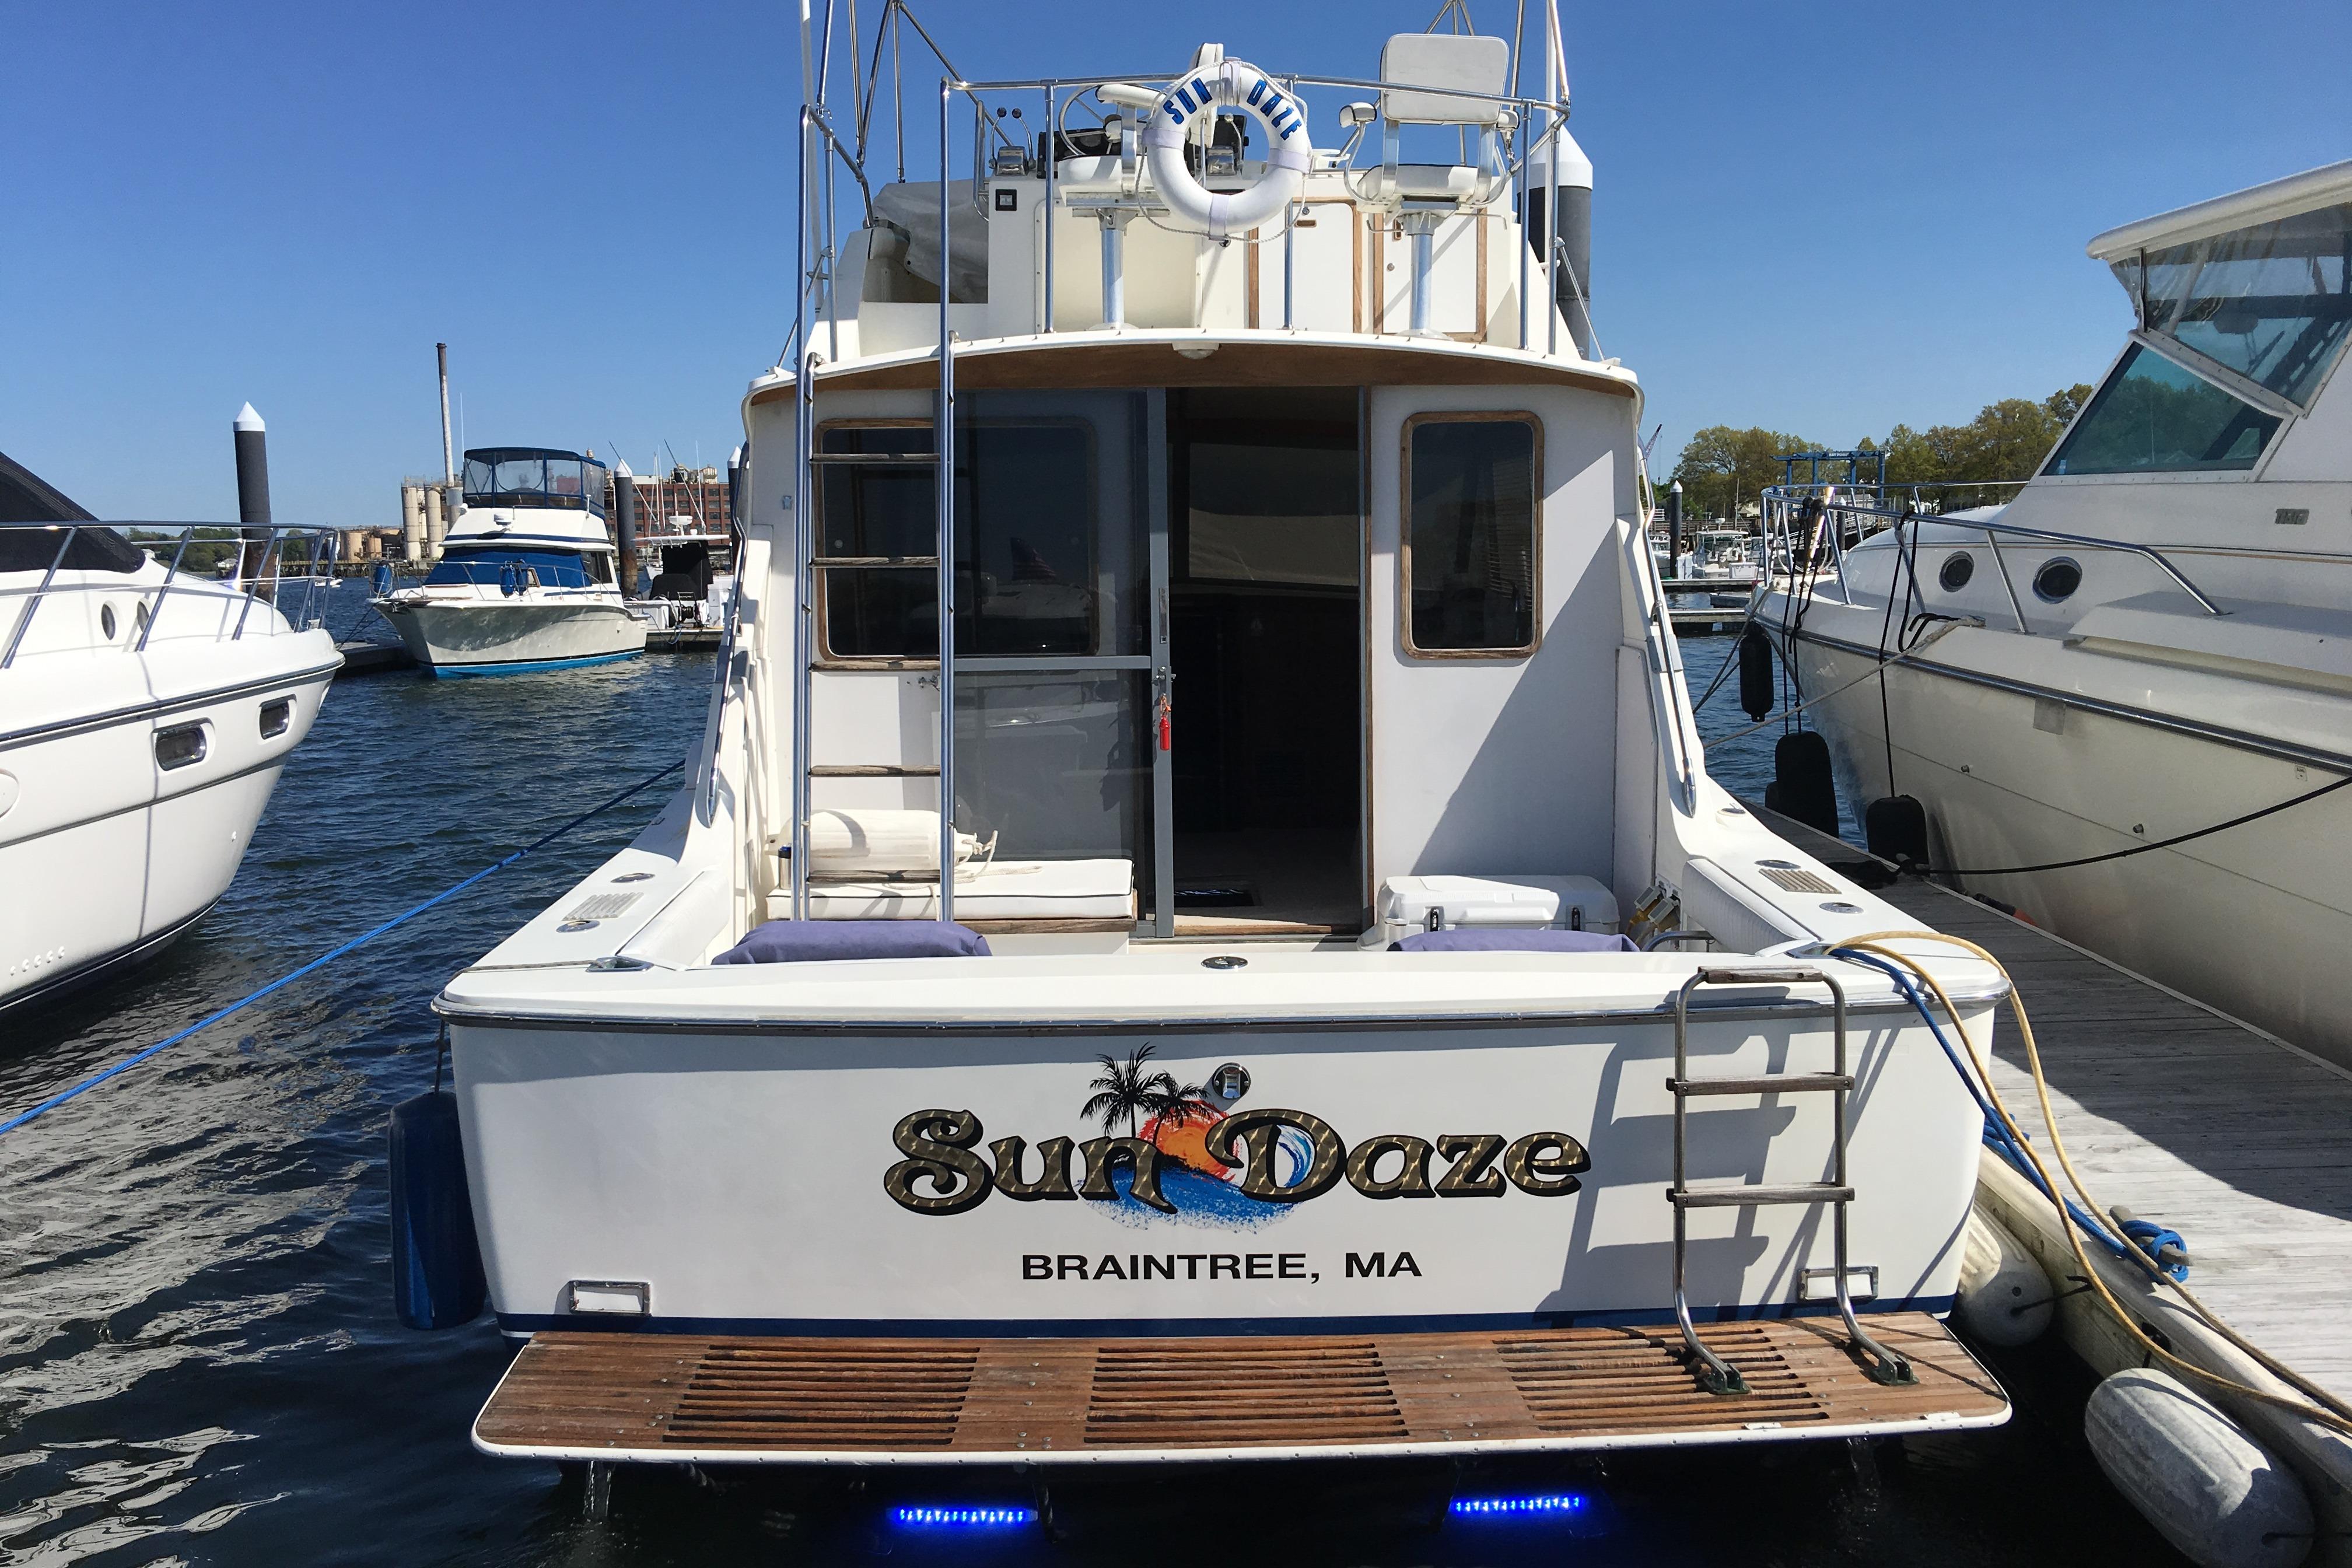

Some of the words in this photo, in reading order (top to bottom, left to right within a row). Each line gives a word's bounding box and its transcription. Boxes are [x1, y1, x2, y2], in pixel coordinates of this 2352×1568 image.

[1163, 78, 1213, 125] SUN
[1246, 79, 1302, 141] DAZE
[883, 1108, 1178, 1216] Sun
[1205, 1108, 1591, 1203] Daze
[1023, 1254, 1320, 1284] BRAINTREE,
[1345, 1251, 1422, 1278] MA
